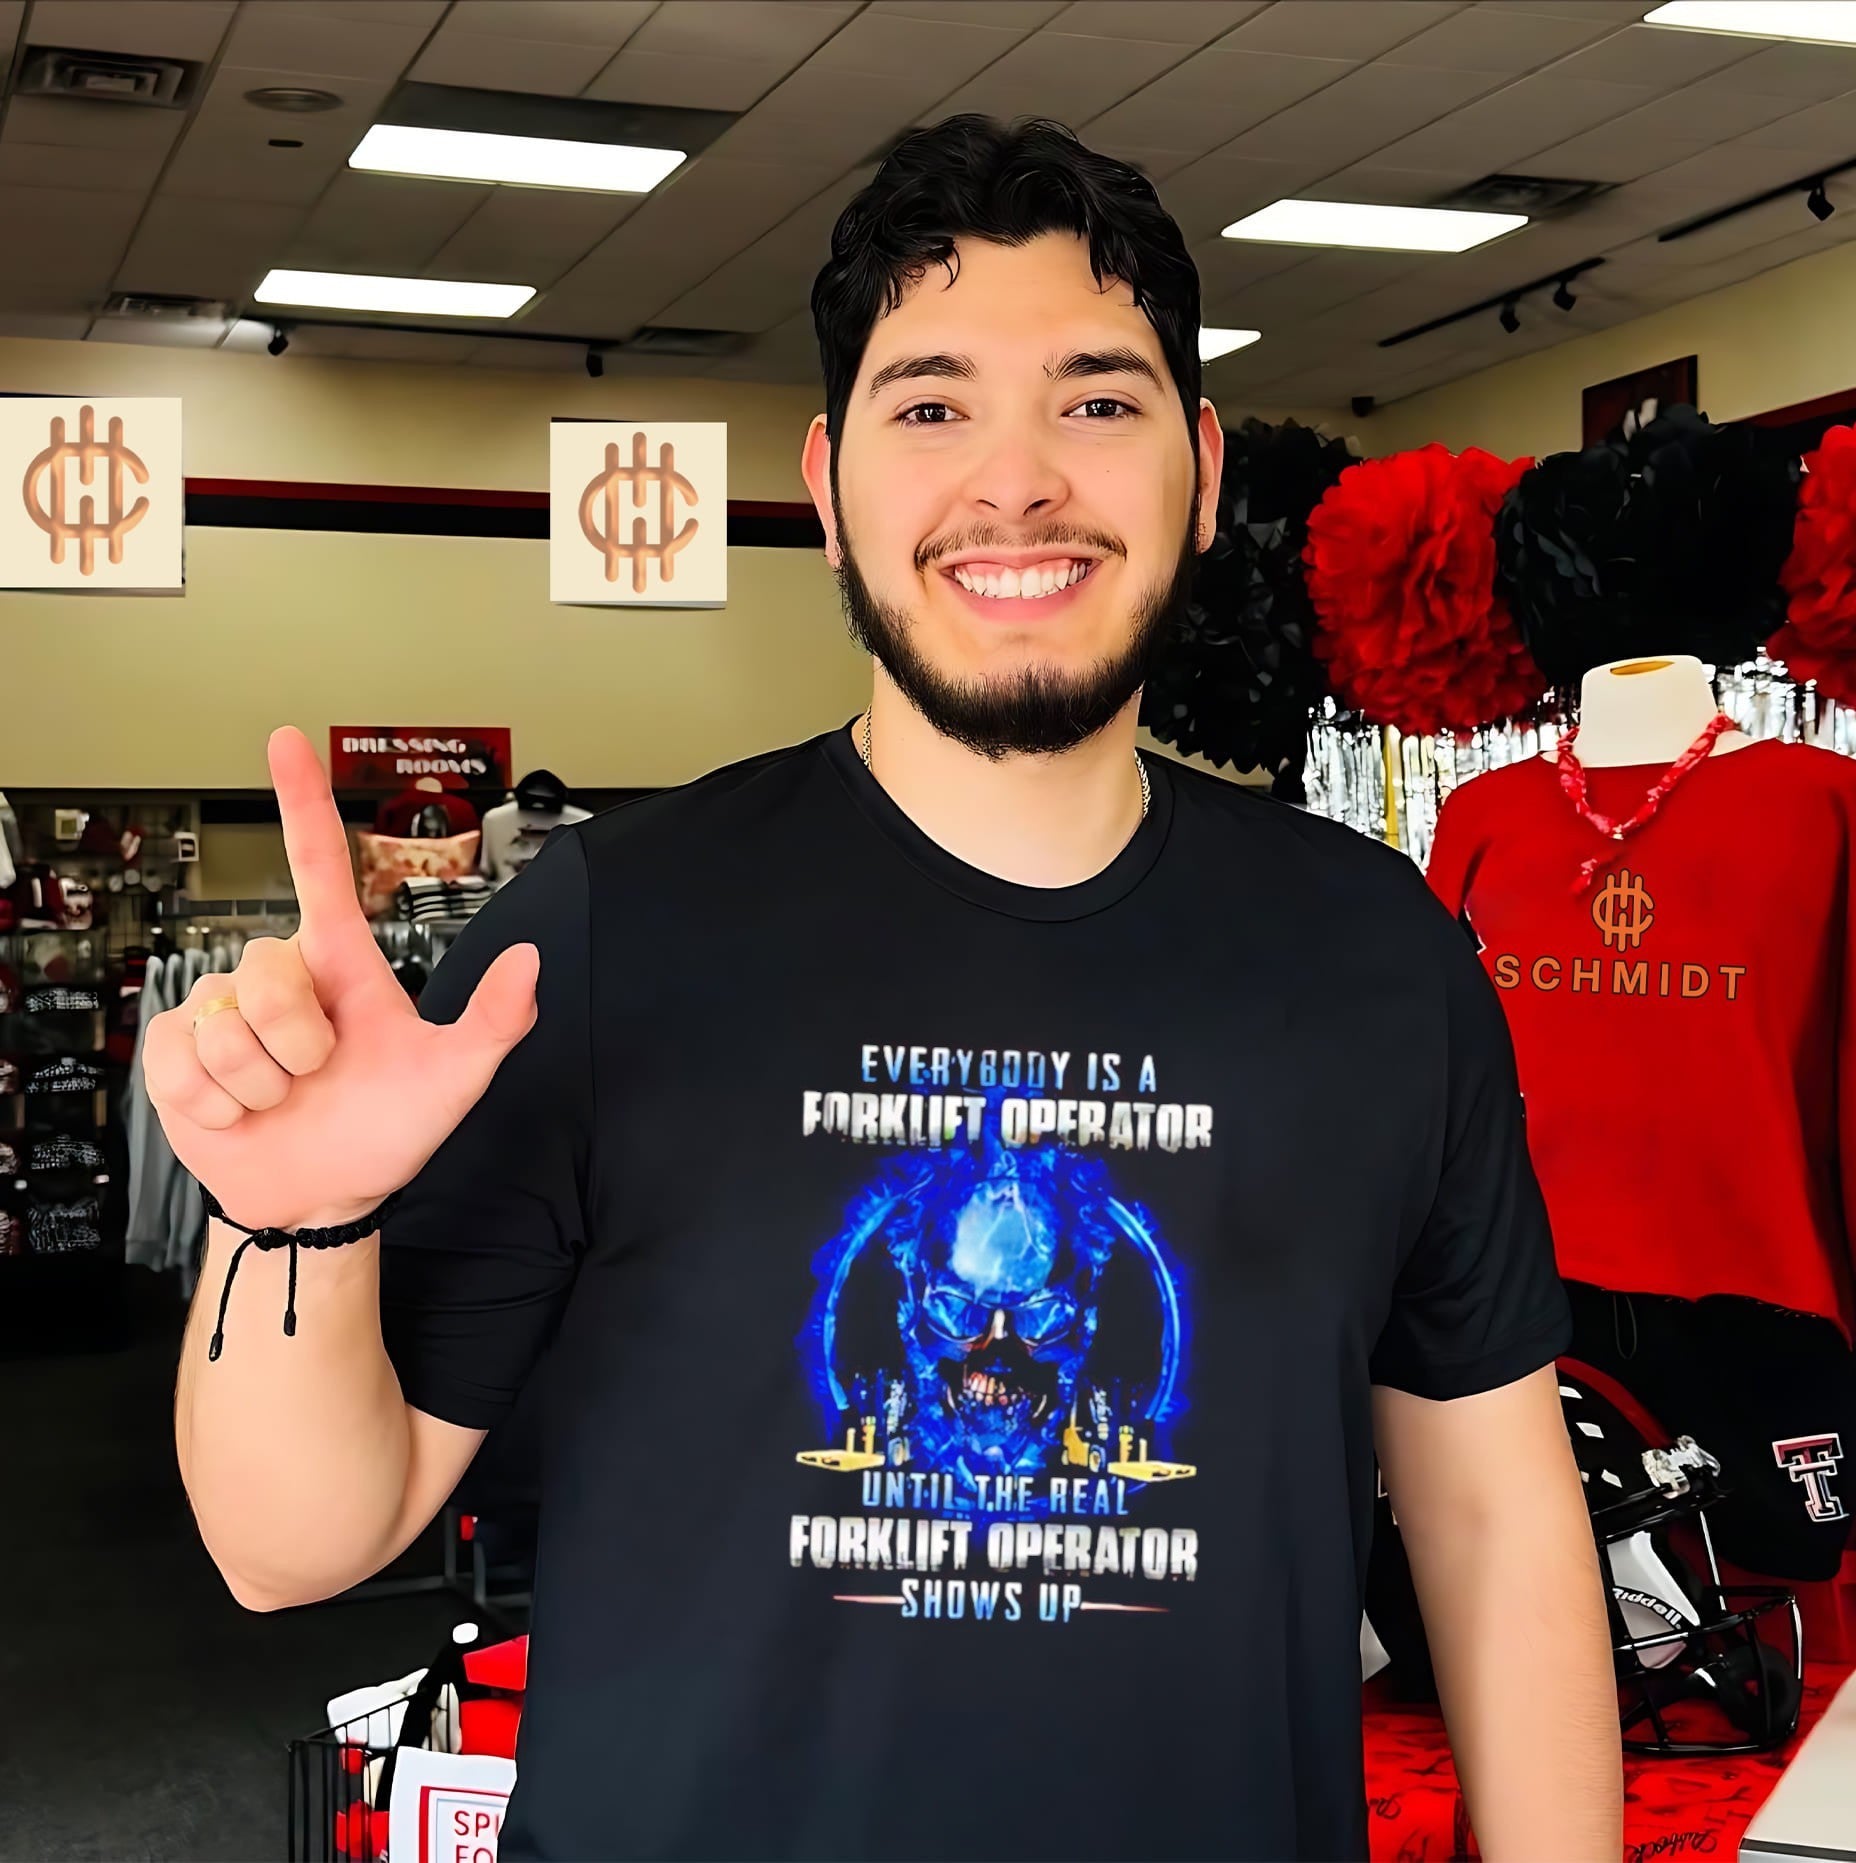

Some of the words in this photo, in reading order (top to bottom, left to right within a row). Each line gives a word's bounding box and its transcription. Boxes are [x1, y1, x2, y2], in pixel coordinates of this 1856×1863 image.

[342, 737, 467, 754] DRESSING
[396, 758, 487, 776] ROOMS
[1493, 954, 1747, 1001] SCHMIDT
[861, 1044, 1071, 1089] EVERYBODY
[1087, 1052, 1121, 1092] IS
[1138, 1054, 1157, 1093] A
[803, 1090, 987, 1146] FORKLIFT
[1001, 1097, 1213, 1153] OPERATOR
[862, 1470, 957, 1508] UNTIL
[975, 1474, 1035, 1513] THE
[1050, 1477, 1129, 1515] REAL
[789, 1515, 973, 1572] FORKLIFT
[987, 1521, 1199, 1581] OPERATOR
[901, 1578, 1022, 1621] SHOWS
[1039, 1582, 1082, 1623] UP
